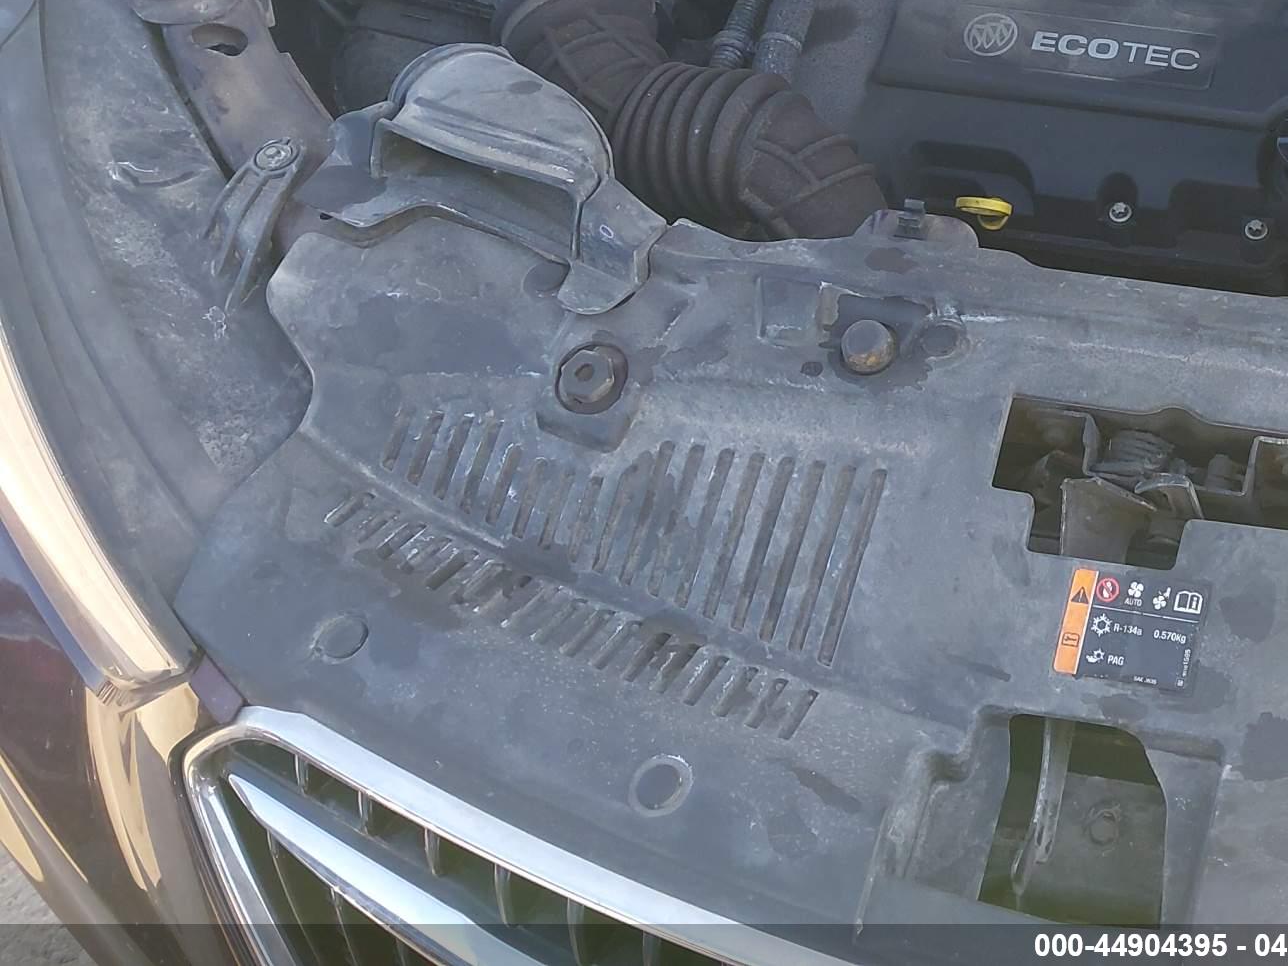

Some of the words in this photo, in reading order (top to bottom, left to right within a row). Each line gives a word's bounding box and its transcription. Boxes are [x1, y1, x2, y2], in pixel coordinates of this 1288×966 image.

[1031, 31, 1201, 71] ECOTEC
[1124, 598, 1142, 607] AUTO
[1113, 623, 1143, 636] R-134a
[1107, 654, 1125, 666] PAG
